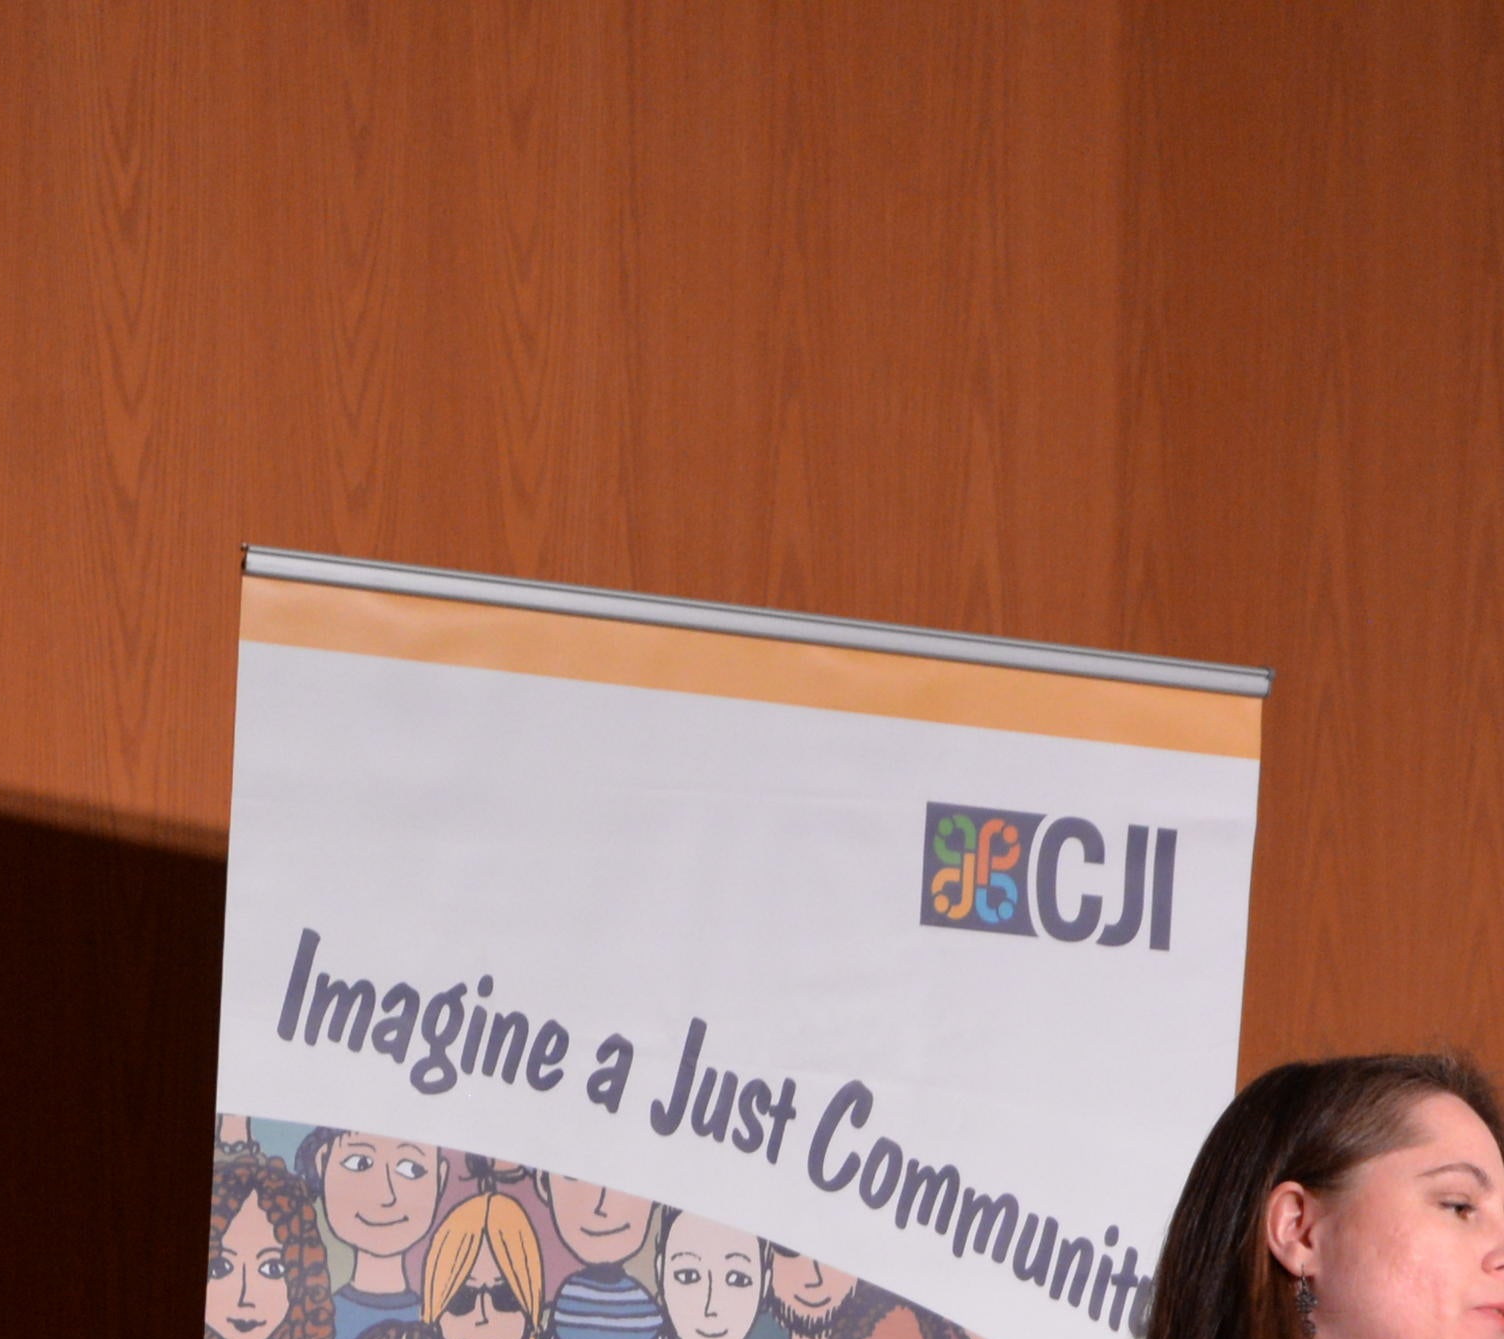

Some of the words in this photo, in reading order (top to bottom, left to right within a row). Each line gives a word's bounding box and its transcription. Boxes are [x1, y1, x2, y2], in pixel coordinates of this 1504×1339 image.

[1036, 816, 1178, 951] CJI
[277, 927, 569, 1095] Imagine
[586, 1032, 634, 1114] a
[650, 1016, 796, 1165] Just
